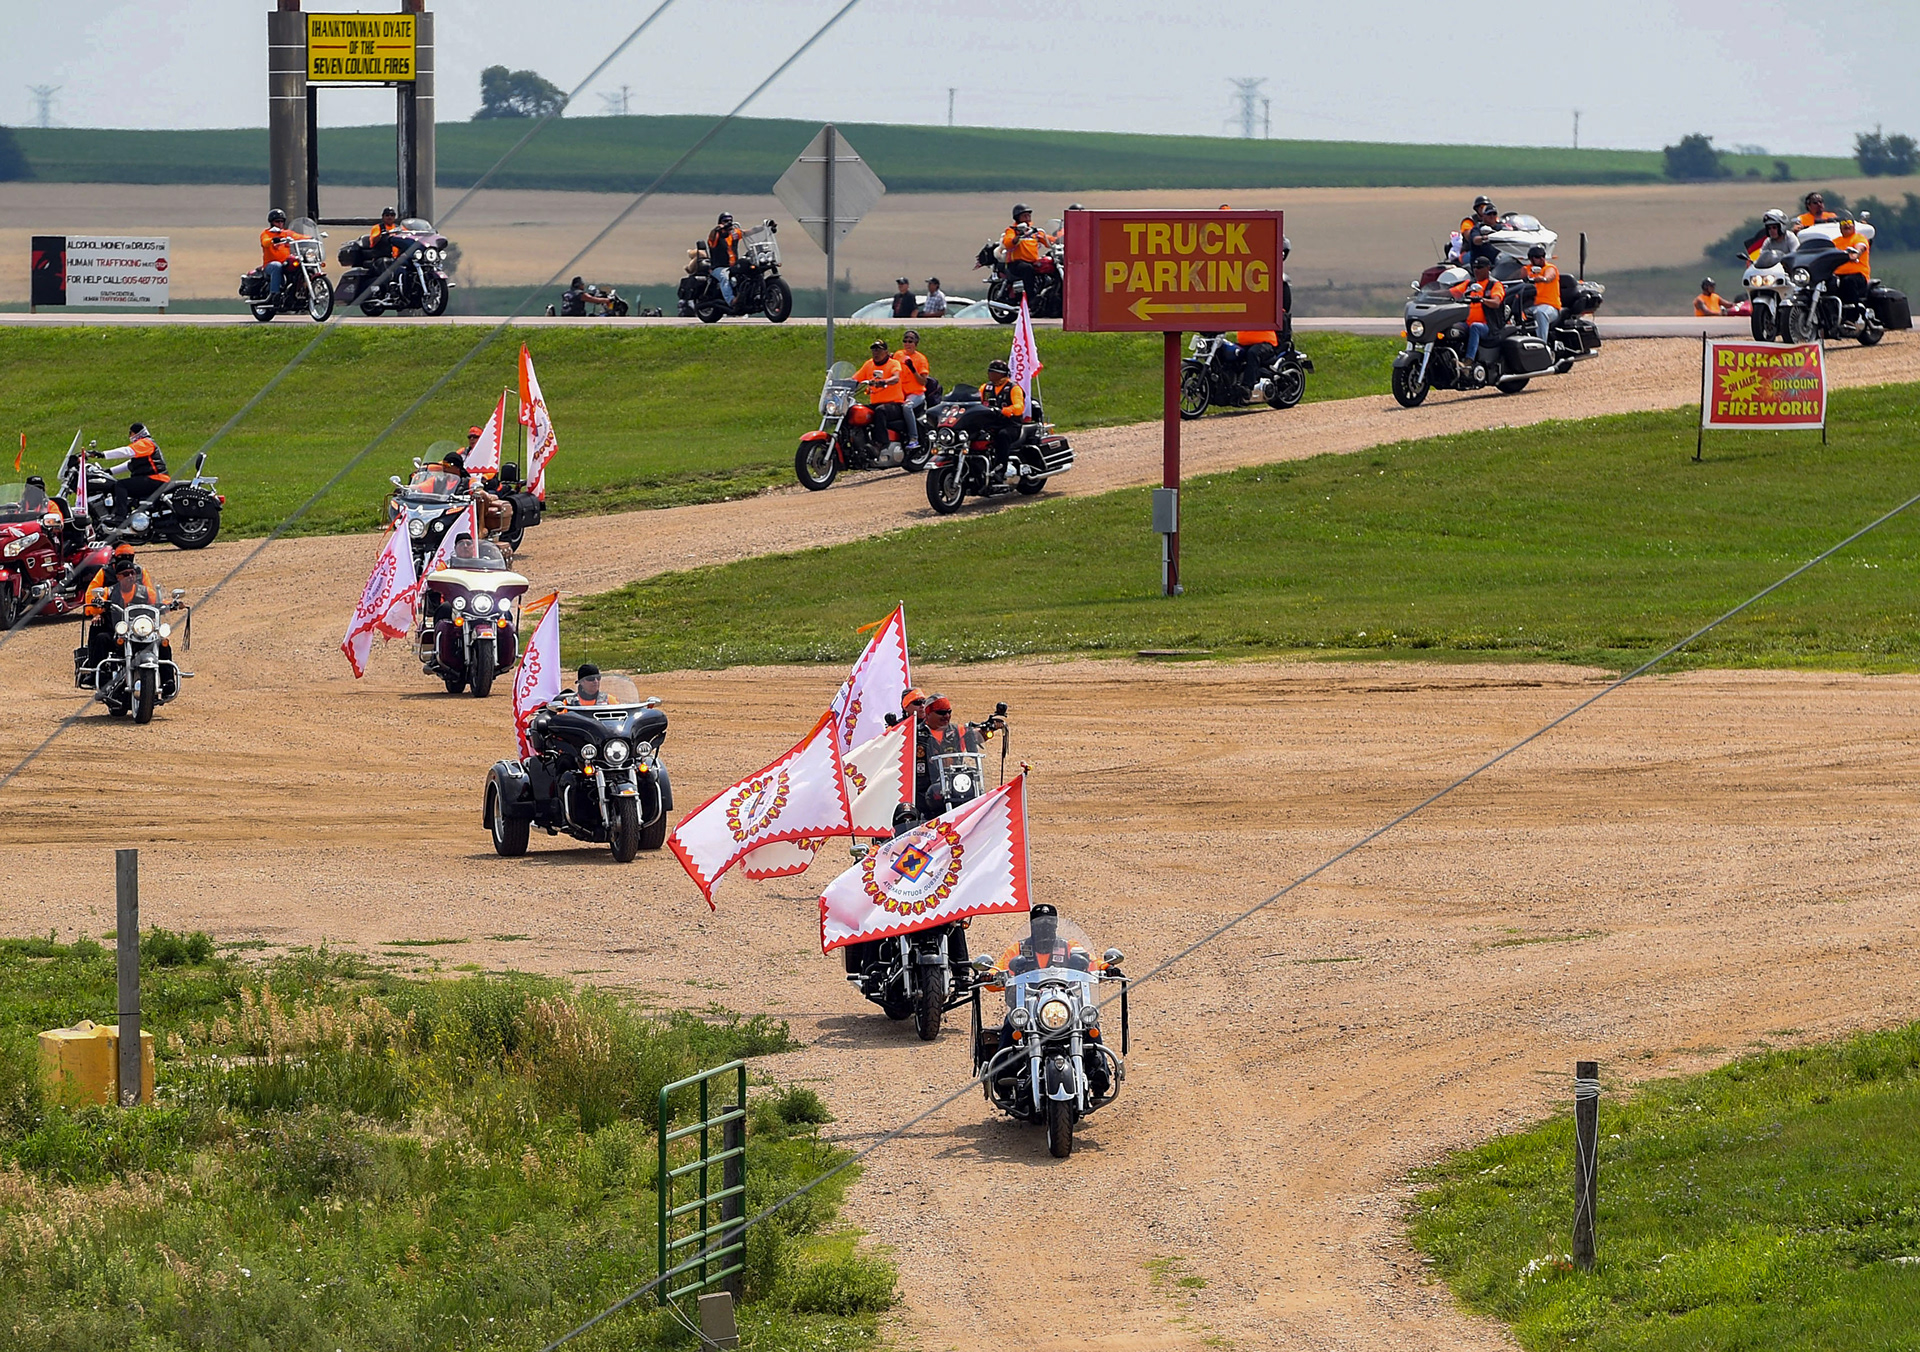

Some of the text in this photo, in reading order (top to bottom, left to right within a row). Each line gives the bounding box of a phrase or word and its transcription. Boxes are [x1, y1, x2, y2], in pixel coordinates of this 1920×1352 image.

[312, 20, 412, 38] IHANKTONWAN OYATE
[349, 40, 375, 55] OF THE
[314, 57, 410, 74] SEVEN COUNCIL FIRES
[132, 241, 155, 251] DRUGS
[1123, 222, 1251, 255] TRUCK
[66, 258, 94, 267] HUMAN
[96, 258, 142, 268] TRAFFICKING
[66, 275, 81, 284] FOR
[83, 275, 102, 284] HELP
[1104, 260, 1270, 293] PARKING
[1718, 348, 1818, 367] RICHARD'S
[1728, 381, 1739, 393] ON
[1773, 378, 1819, 391] DISCOUNT
[1717, 400, 1819, 416] FIREWORKS
